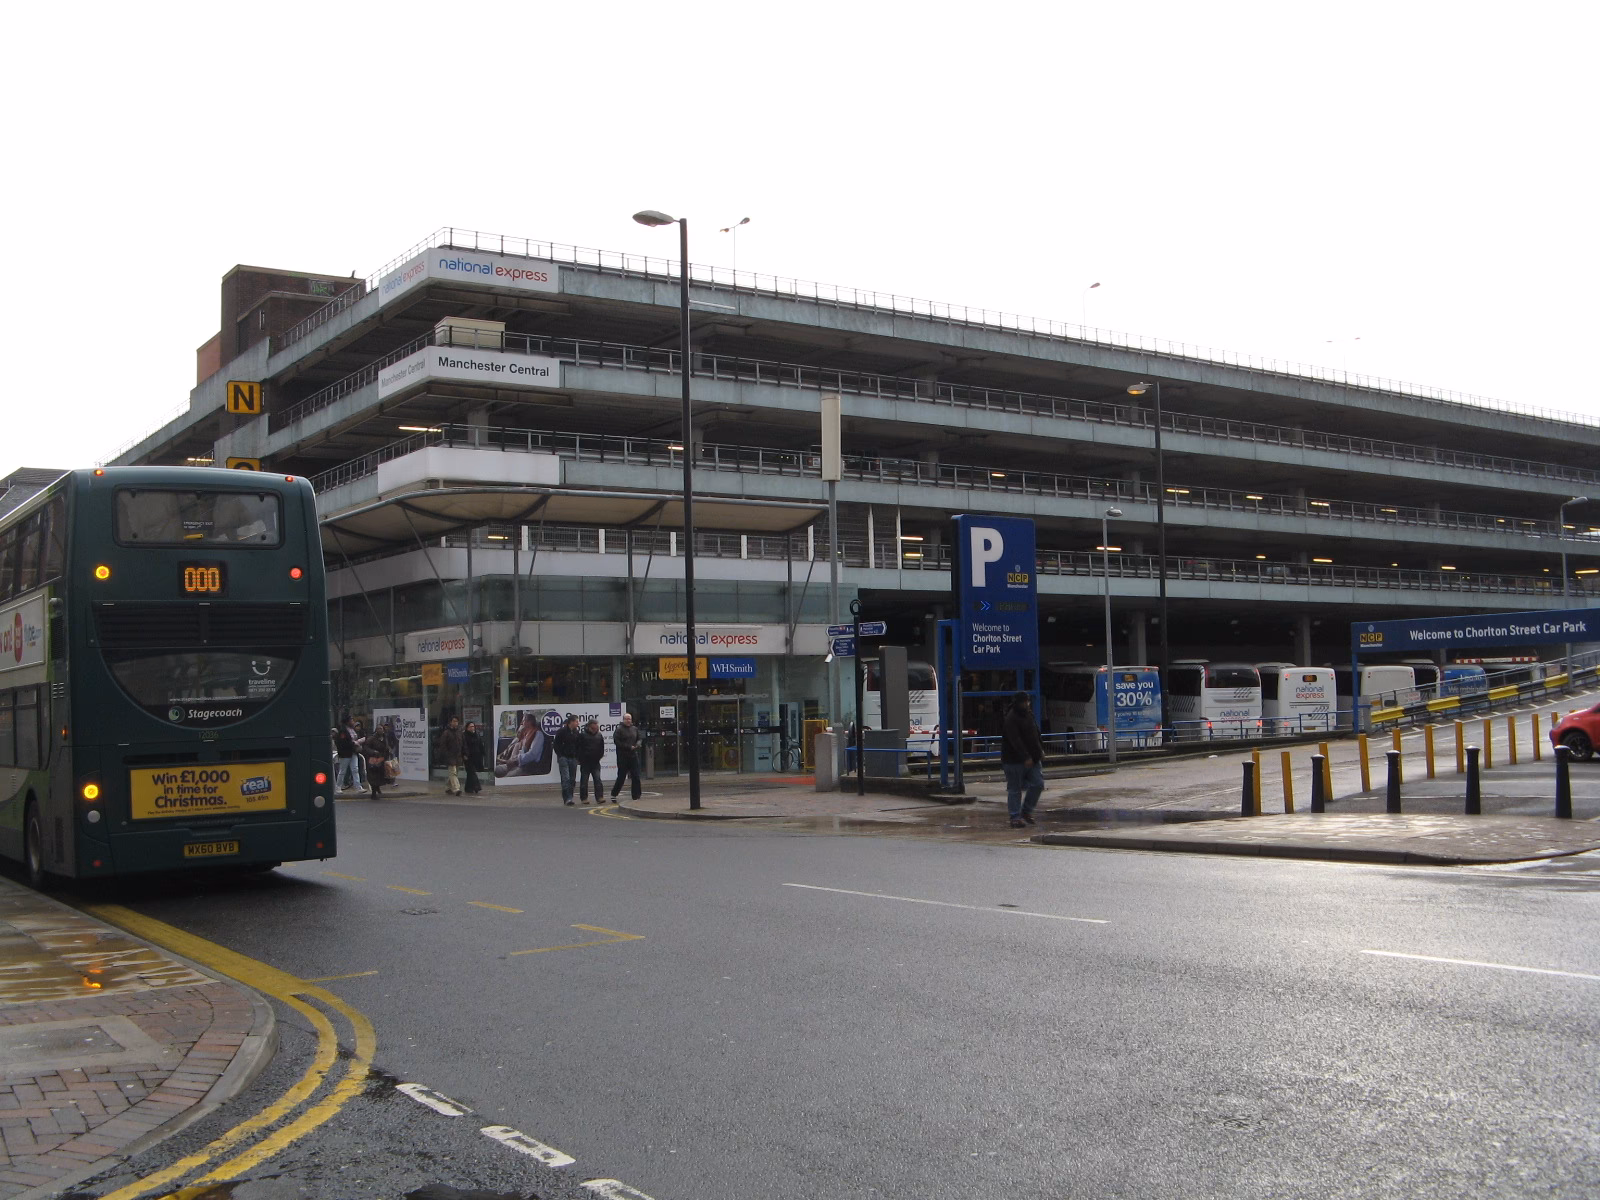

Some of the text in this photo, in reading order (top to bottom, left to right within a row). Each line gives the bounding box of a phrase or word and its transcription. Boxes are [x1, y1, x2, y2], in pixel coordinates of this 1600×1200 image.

[439, 258, 548, 282] national express
[439, 357, 549, 377] Manchester Central
[233, 384, 254, 410] N
[970, 526, 1004, 587] P
[184, 567, 220, 592] 000
[1008, 574, 1028, 583] NCP
[972, 623, 1010, 632] Welcome to
[1410, 621, 1587, 641] Welcome to Chorlton Street Car Park
[711, 635, 758, 648] express
[972, 634, 1022, 643] Chorlton Street
[1361, 633, 1383, 642] NCP
[418, 637, 465, 653] national express
[973, 645, 1001, 654] Car Park
[712, 663, 753, 673] WHSmith
[1115, 682, 1136, 690] save
[1137, 682, 1154, 690] you
[1296, 685, 1324, 693] national
[1296, 692, 1325, 700] express
[187, 708, 243, 720] Stagecoach
[1220, 708, 1250, 717] national
[402, 719, 417, 729] Senior
[543, 715, 561, 726] £10
[152, 770, 230, 785] Win £1,000
[163, 784, 218, 794] in time for
[242, 778, 269, 792] real
[155, 795, 227, 808] Christmas.
[188, 843, 235, 855] MX60 BVB
